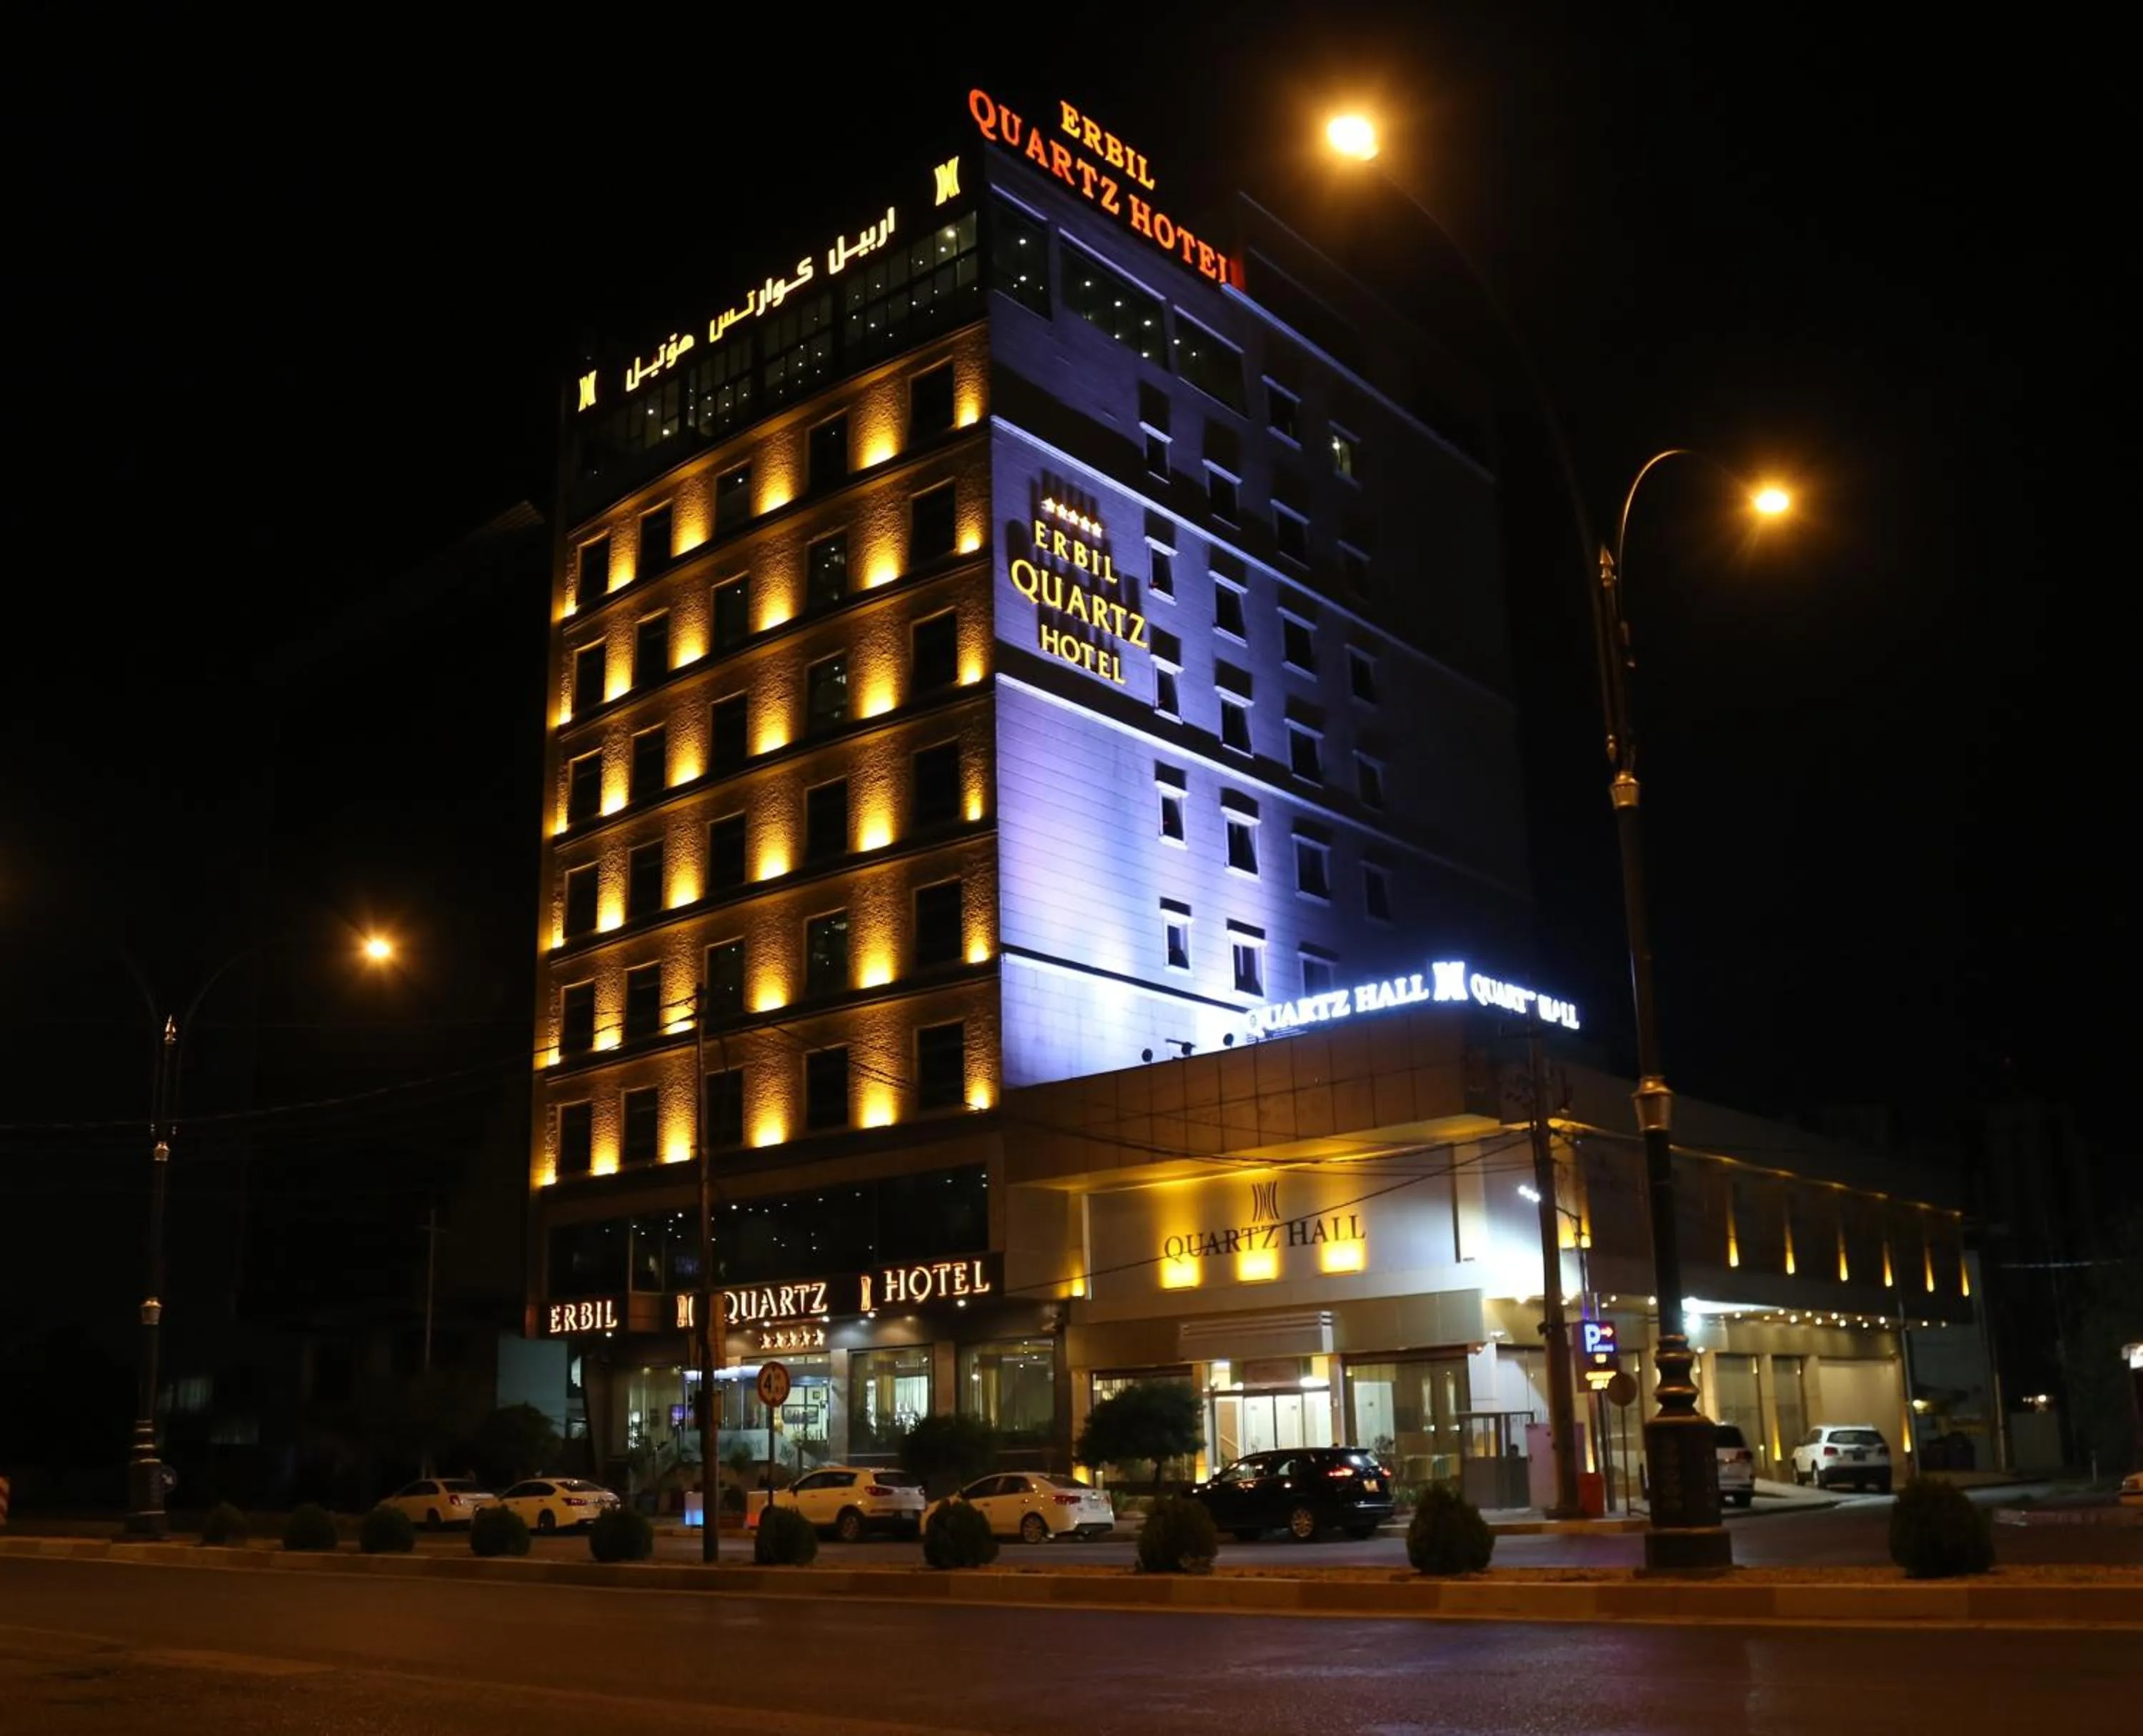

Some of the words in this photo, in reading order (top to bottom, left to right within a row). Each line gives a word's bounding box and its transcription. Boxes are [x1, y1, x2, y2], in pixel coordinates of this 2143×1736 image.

[969, 89, 1120, 214] QUARTZ
[1060, 100, 1155, 190] ERBIL
[1034, 519, 1117, 584] ERBIL
[1011, 559, 1148, 648] QUARTZ
[1041, 624, 1126, 684] HOTEL
[1245, 990, 1352, 1037] QUARTZ
[1354, 974, 1429, 1013] HALL
[1164, 1224, 1279, 1264] QUARTZ
[1288, 1215, 1365, 1247] HALL
[549, 1300, 618, 1333] ERBIL
[884, 1261, 990, 1302] HOTEL
[1584, 1324, 1601, 1352] P
